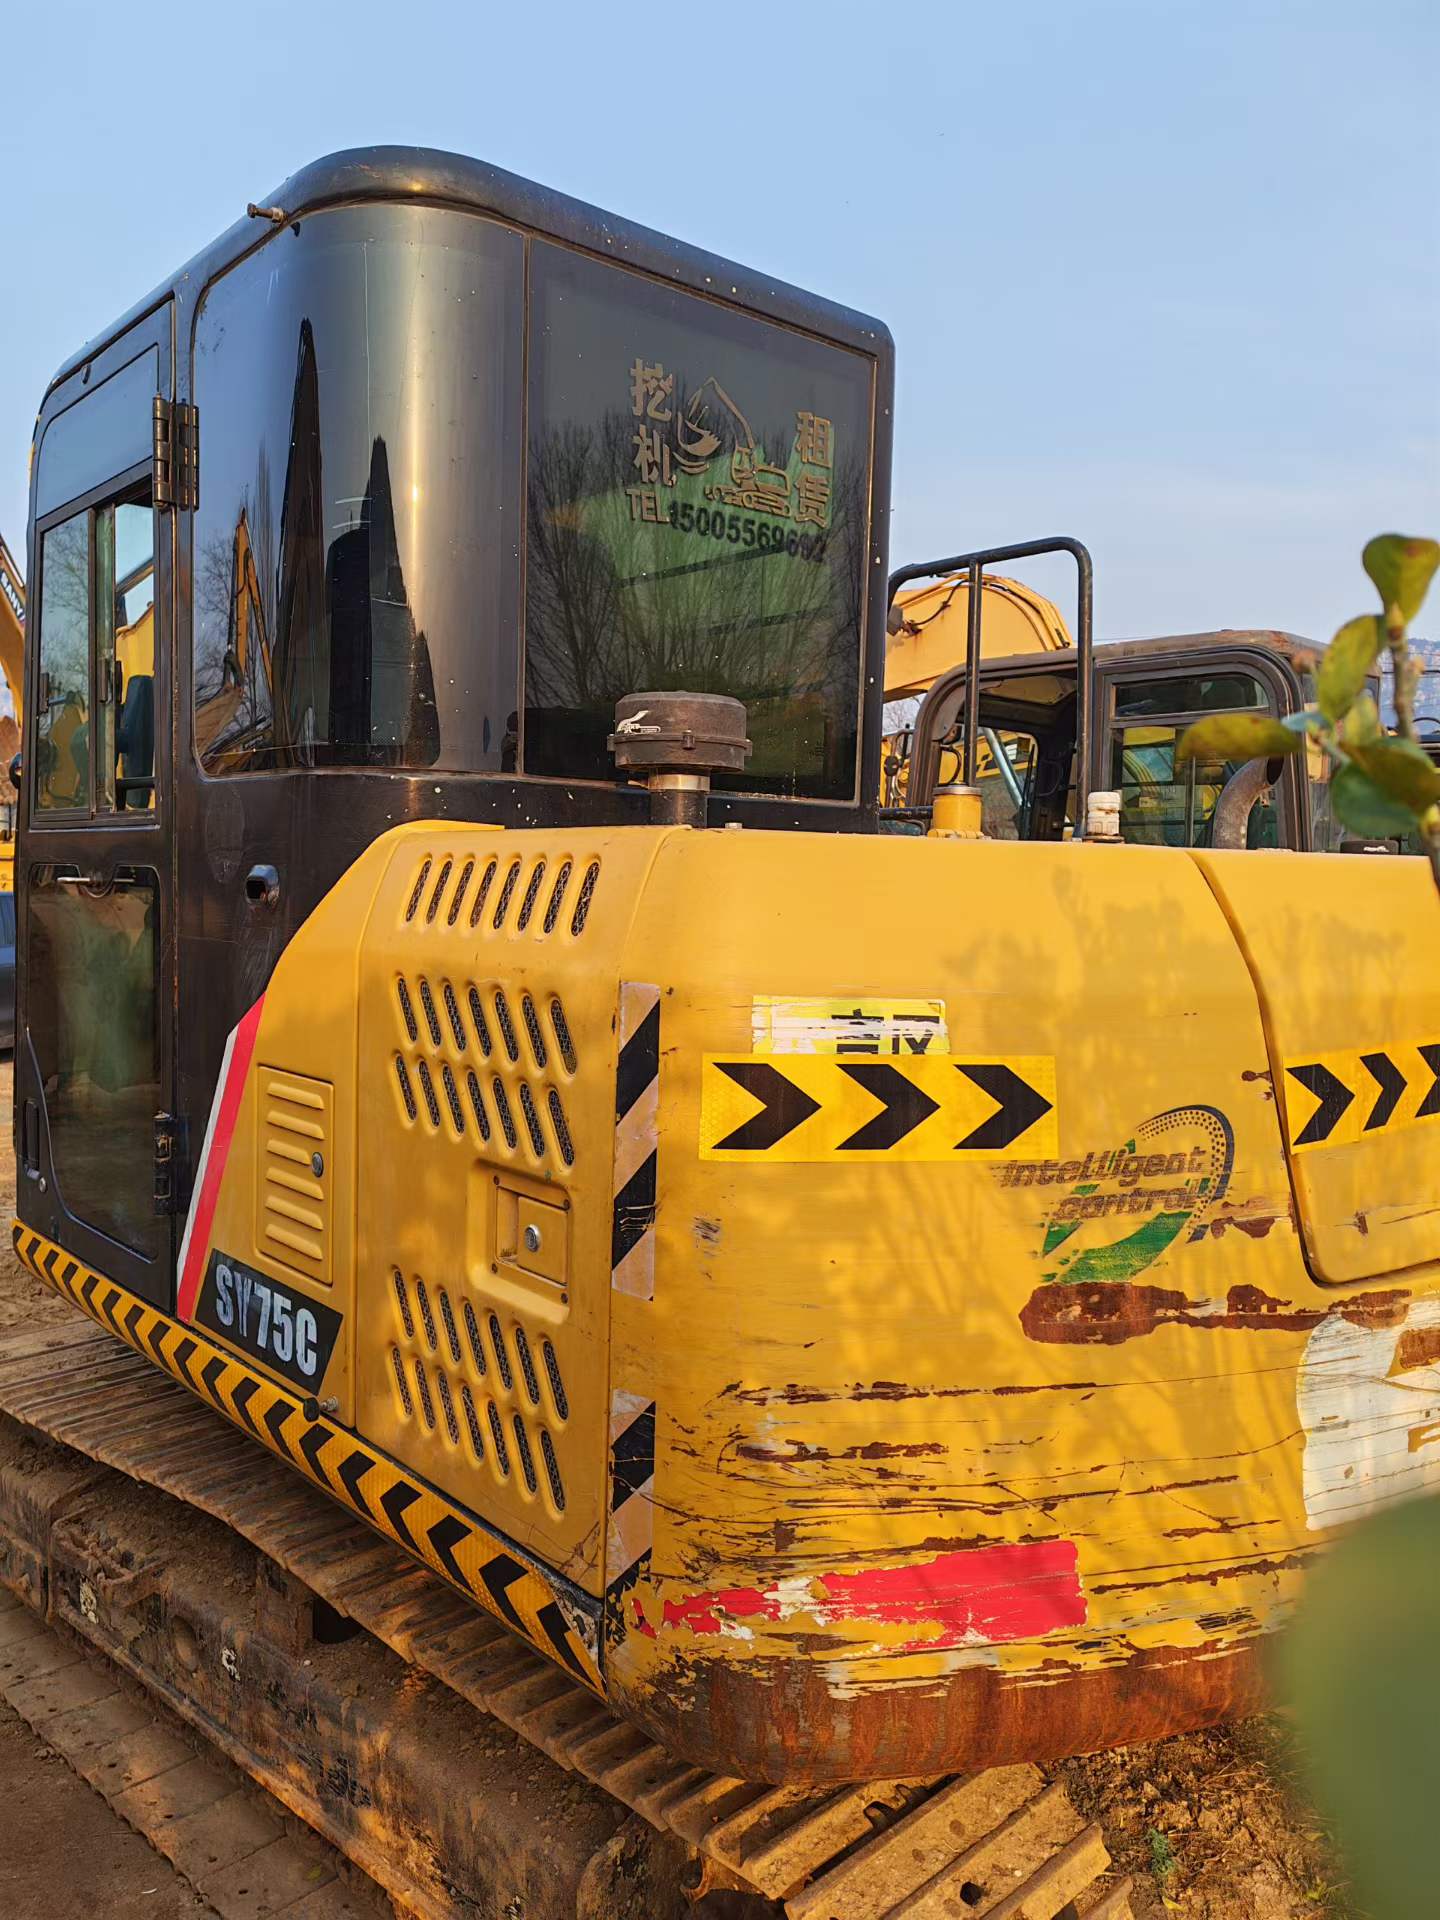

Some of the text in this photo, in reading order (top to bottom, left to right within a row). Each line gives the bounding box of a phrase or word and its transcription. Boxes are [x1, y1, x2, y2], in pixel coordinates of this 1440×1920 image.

[630, 358, 677, 487] 挖机
[795, 411, 831, 528] 租赁
[626, 488, 671, 523] TEL
[216, 1264, 317, 1376] SY75C
